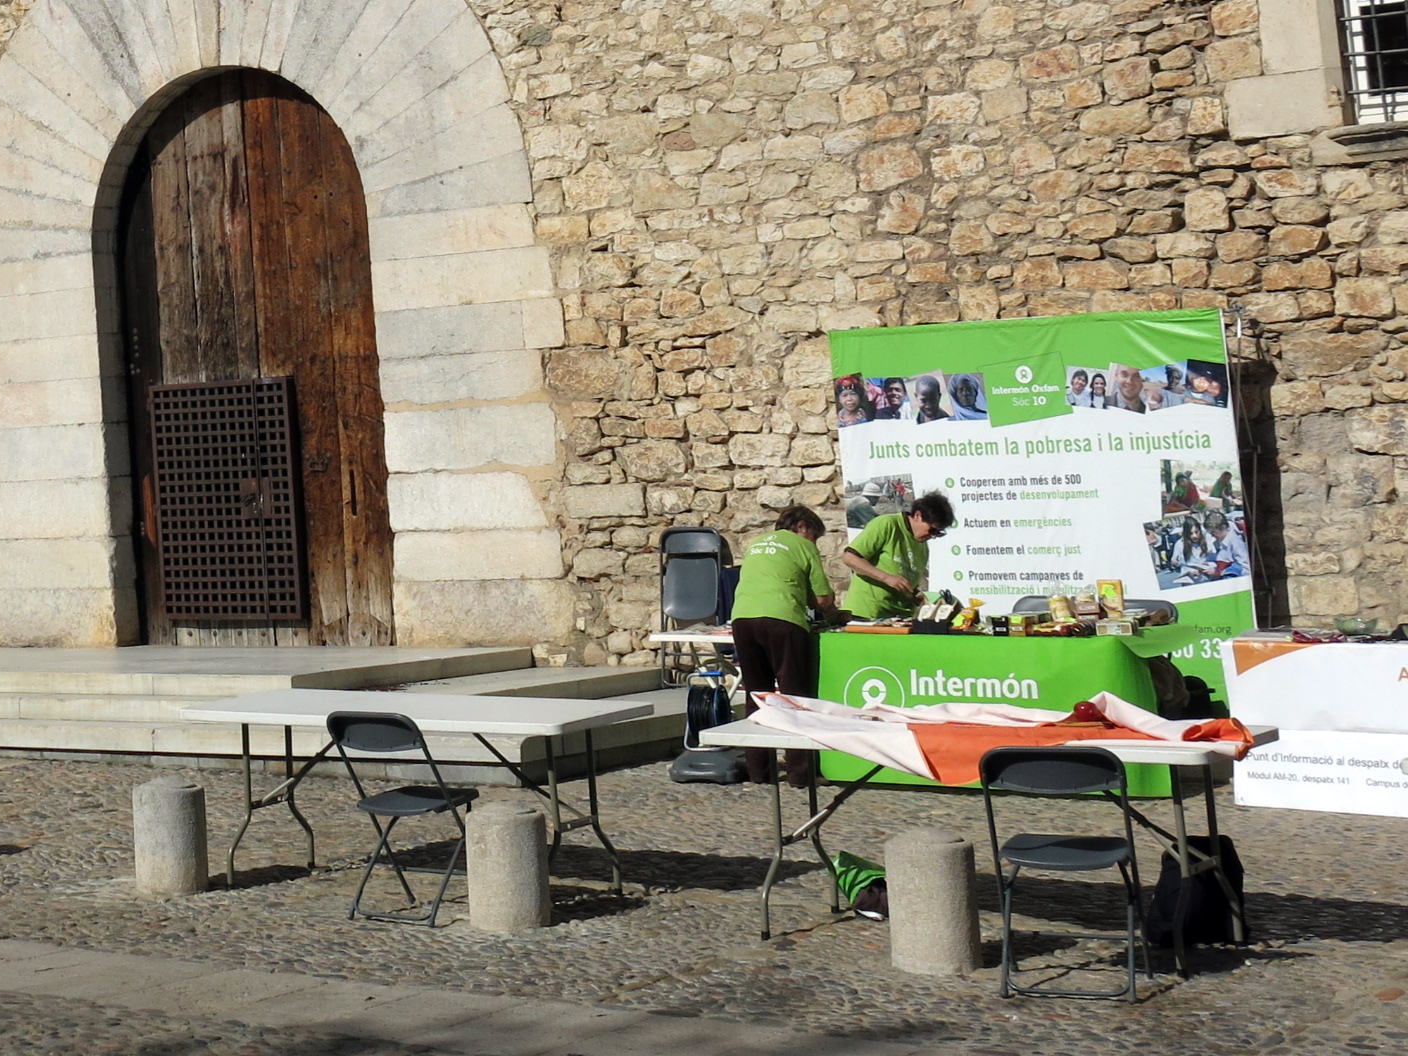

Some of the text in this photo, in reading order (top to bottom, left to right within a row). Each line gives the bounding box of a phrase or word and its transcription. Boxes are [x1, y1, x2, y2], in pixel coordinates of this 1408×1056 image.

[992, 383, 1060, 394] Intermón Oxfam
[869, 430, 1212, 459] Junts combatem la pobresa i la injustícia
[960, 473, 1082, 488] Cooperem amb més de 500
[961, 488, 1099, 504] projectes de desenvolupament
[964, 516, 1073, 530] Actuem en emergències
[966, 544, 1082, 557] Fomentem el comerç just
[968, 571, 1017, 582] Promovem
[1072, 570, 1084, 581] de
[910, 669, 1039, 699] Intermón
[1246, 751, 1270, 762] Punt
[1272, 753, 1334, 765] d'Informació
[1336, 755, 1345, 766] al
[1348, 756, 1390, 770] despatx
[1302, 775, 1335, 785] despatx
[1337, 776, 1351, 785] 141
[1365, 778, 1400, 789] Campus
